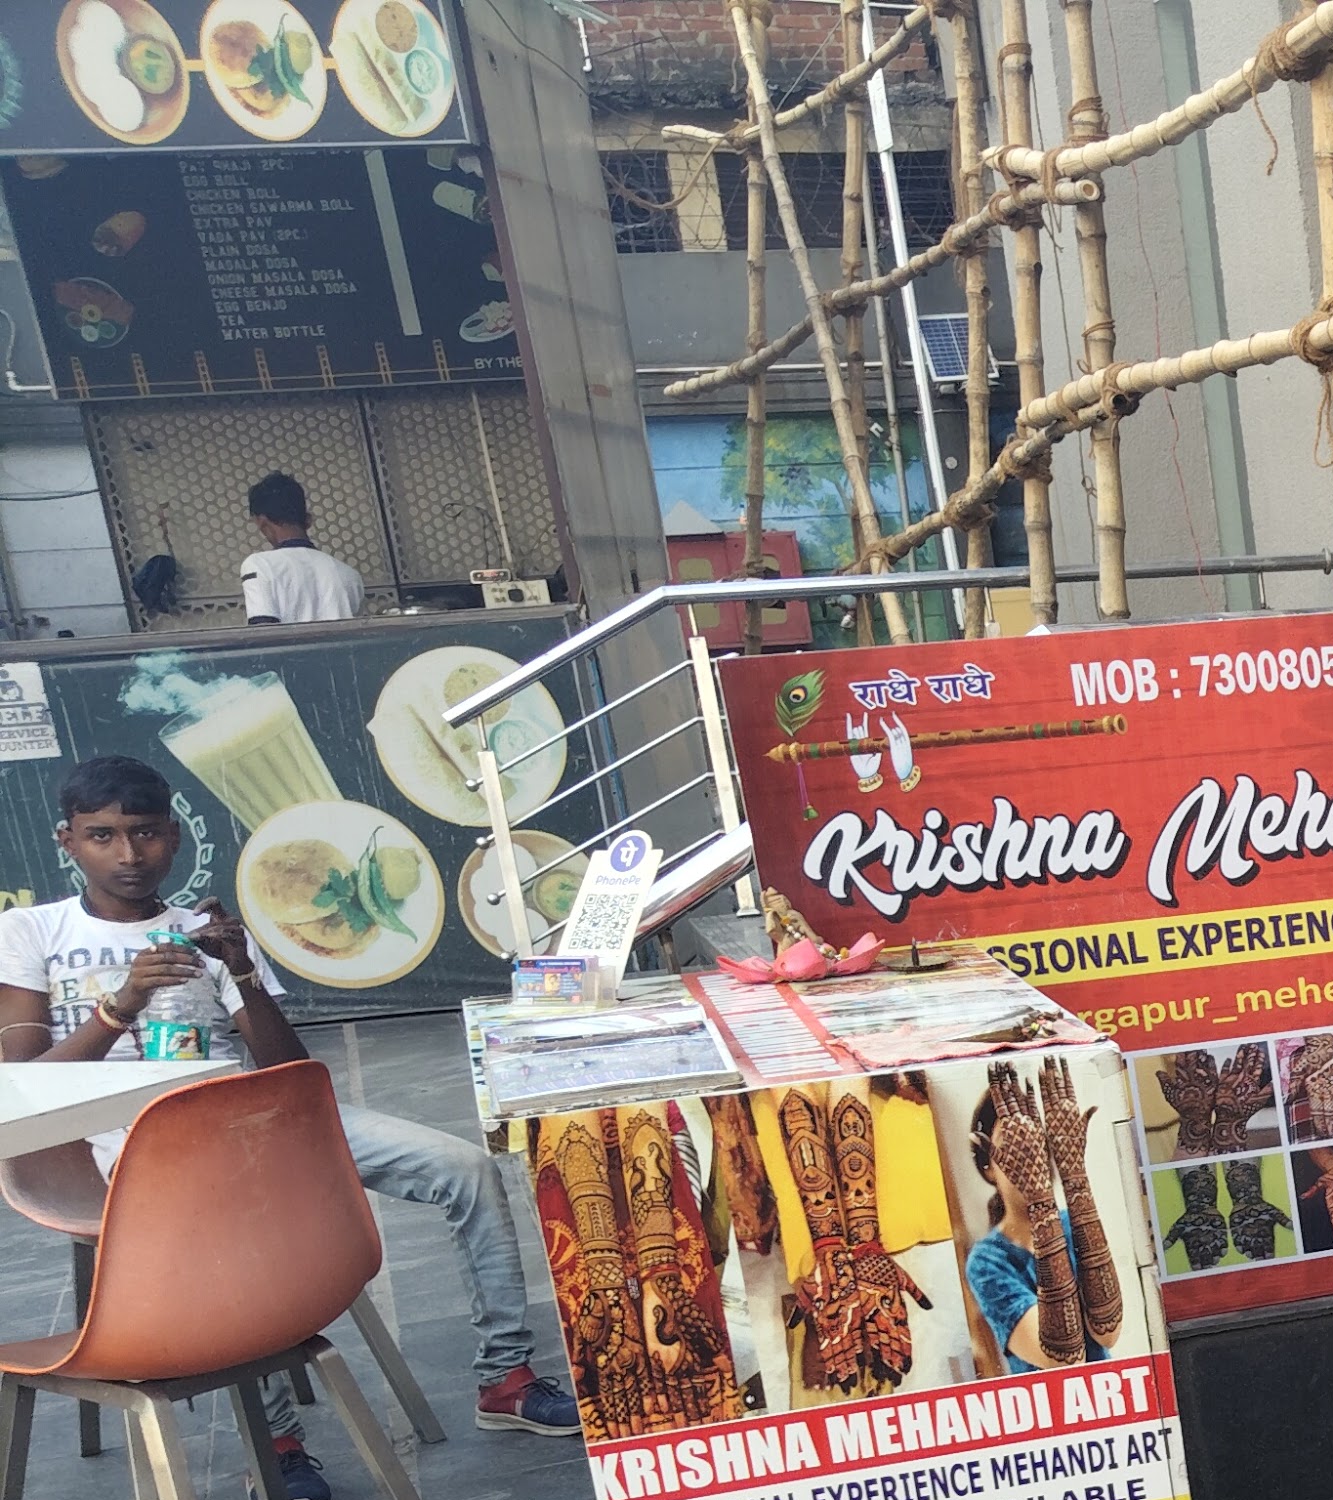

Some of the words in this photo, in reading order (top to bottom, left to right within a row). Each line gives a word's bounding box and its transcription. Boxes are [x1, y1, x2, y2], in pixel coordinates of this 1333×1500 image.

[246, 244, 280, 256] DOSA
[204, 258, 259, 272] MASALA
[265, 257, 299, 270] DOSA
[251, 271, 306, 284] MASALA
[311, 269, 344, 282] DOSA
[211, 286, 259, 299] CHEESE
[265, 284, 319, 297] MASALA
[323, 282, 357, 295] DOSA
[215, 301, 240, 313] EGG
[217, 315, 245, 327] TEA
[221, 327, 269, 341] WATER
[273, 324, 326, 338] BOTTLE
[474, 358, 493, 369] BY
[496, 356, 523, 368] THE
[849, 669, 921, 709] राधे
[926, 663, 995, 703] राधे
[1070, 658, 1159, 707] MOB
[1170, 667, 1182, 699] :
[802, 797, 1128, 920] Krishna
[595, 875, 641, 886] PhonePe
[825, 1379, 1054, 1464] MEHANDI
[1063, 1366, 1152, 1426] ART
[991, 1438, 1119, 1490] MEHANDI
[1126, 1428, 1173, 1469] ART
